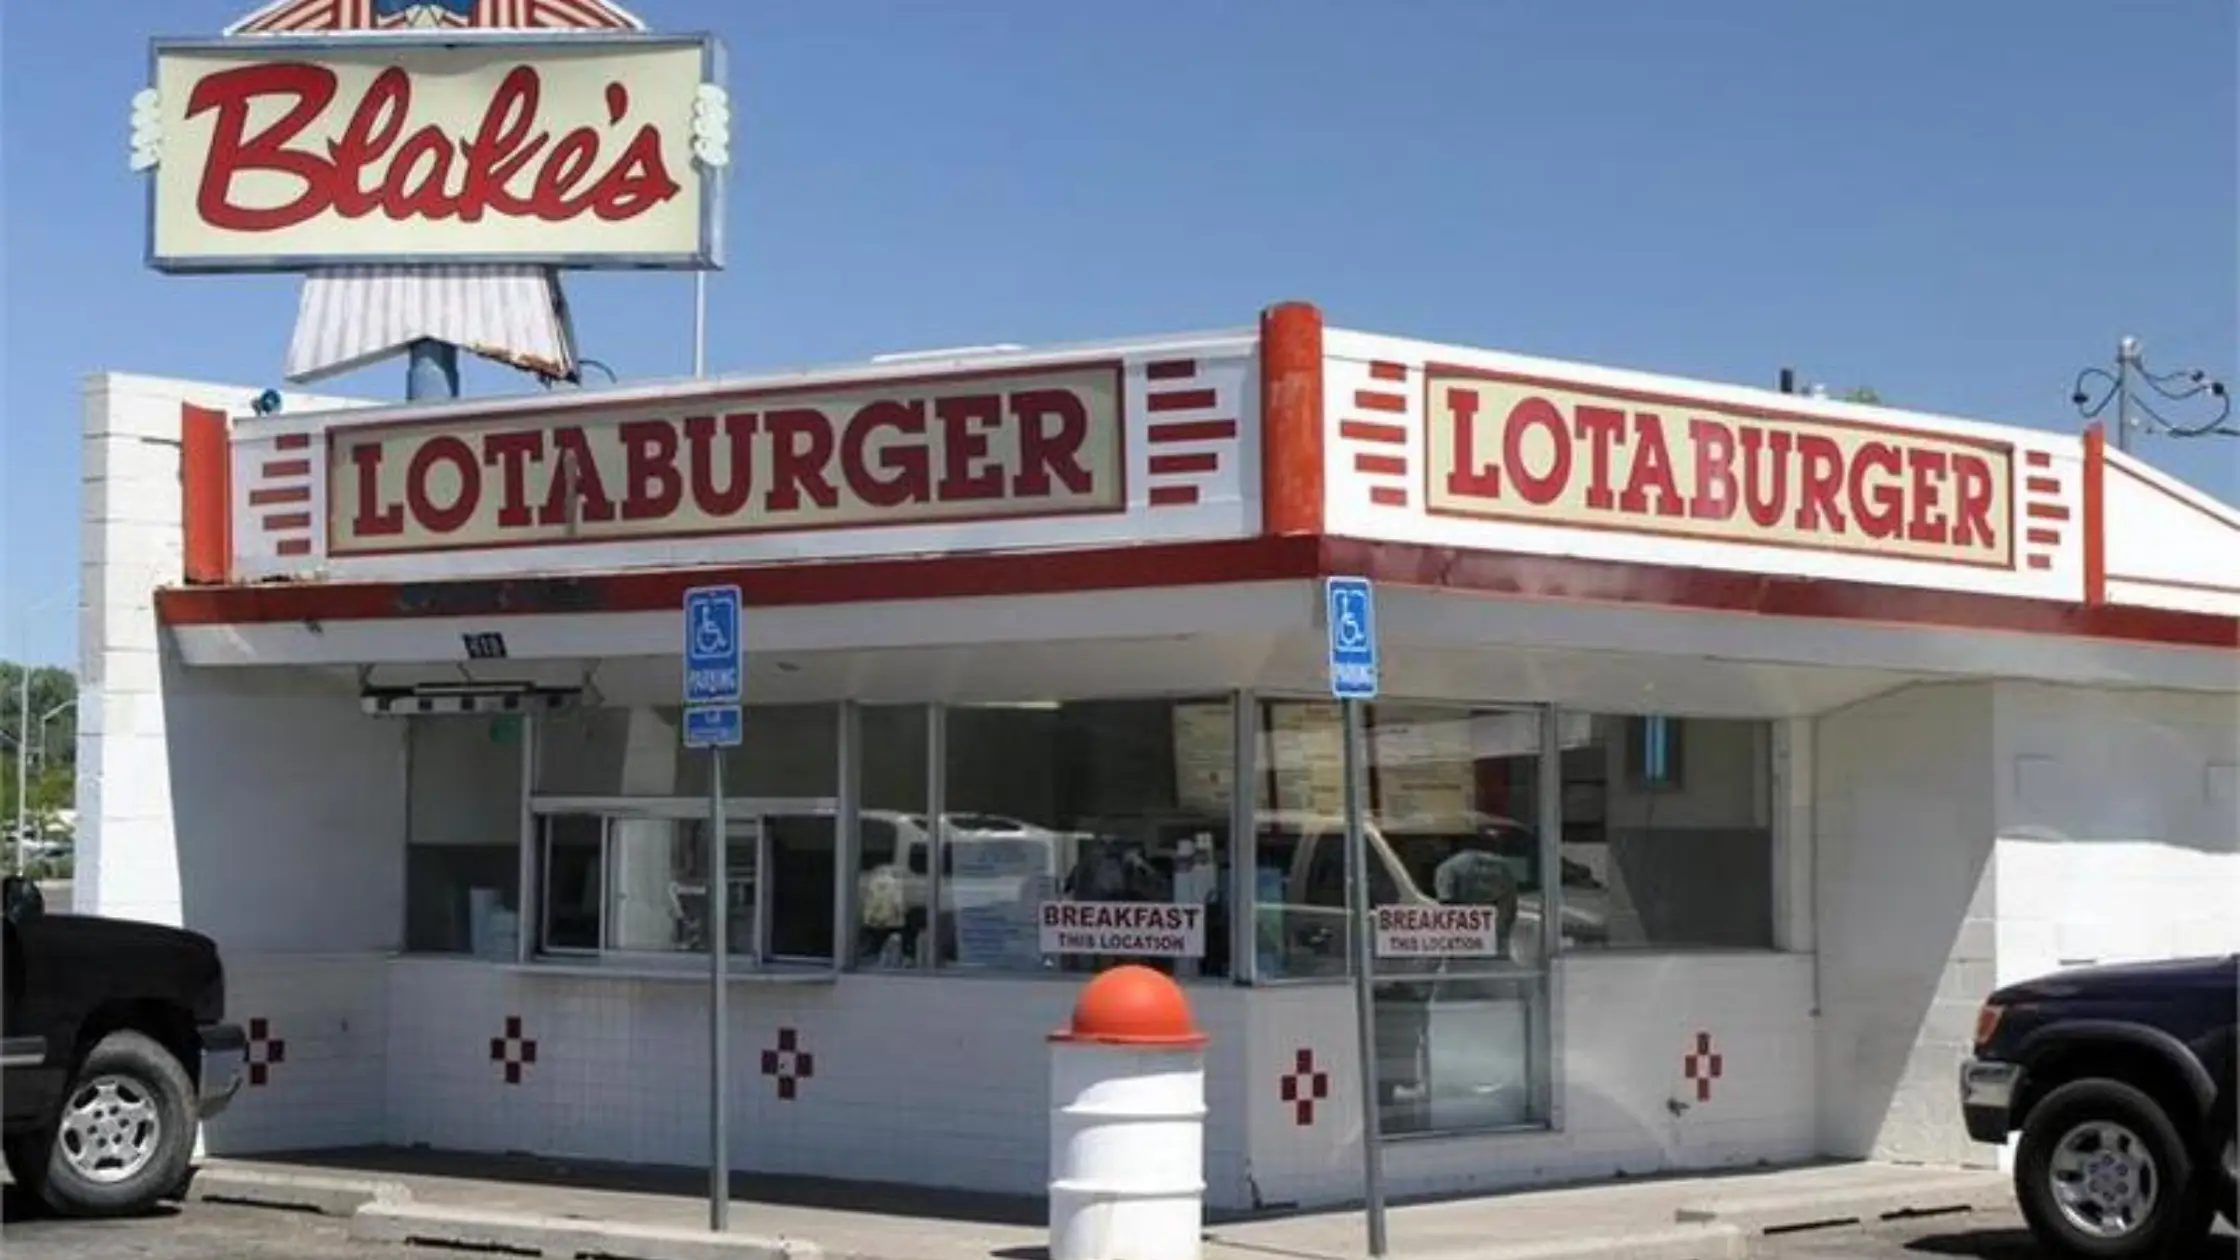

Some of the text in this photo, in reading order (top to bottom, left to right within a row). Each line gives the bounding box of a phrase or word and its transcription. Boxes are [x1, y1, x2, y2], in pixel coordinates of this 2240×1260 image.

[185, 62, 680, 231] Blake's
[352, 388, 1092, 535] LOTABURGER
[1447, 388, 1995, 548] LOTABURGER
[1044, 905, 1199, 929] BREAKFAST
[1059, 932, 1186, 951] THIS LOCATION
[1380, 908, 1492, 931] BREAKFAST
